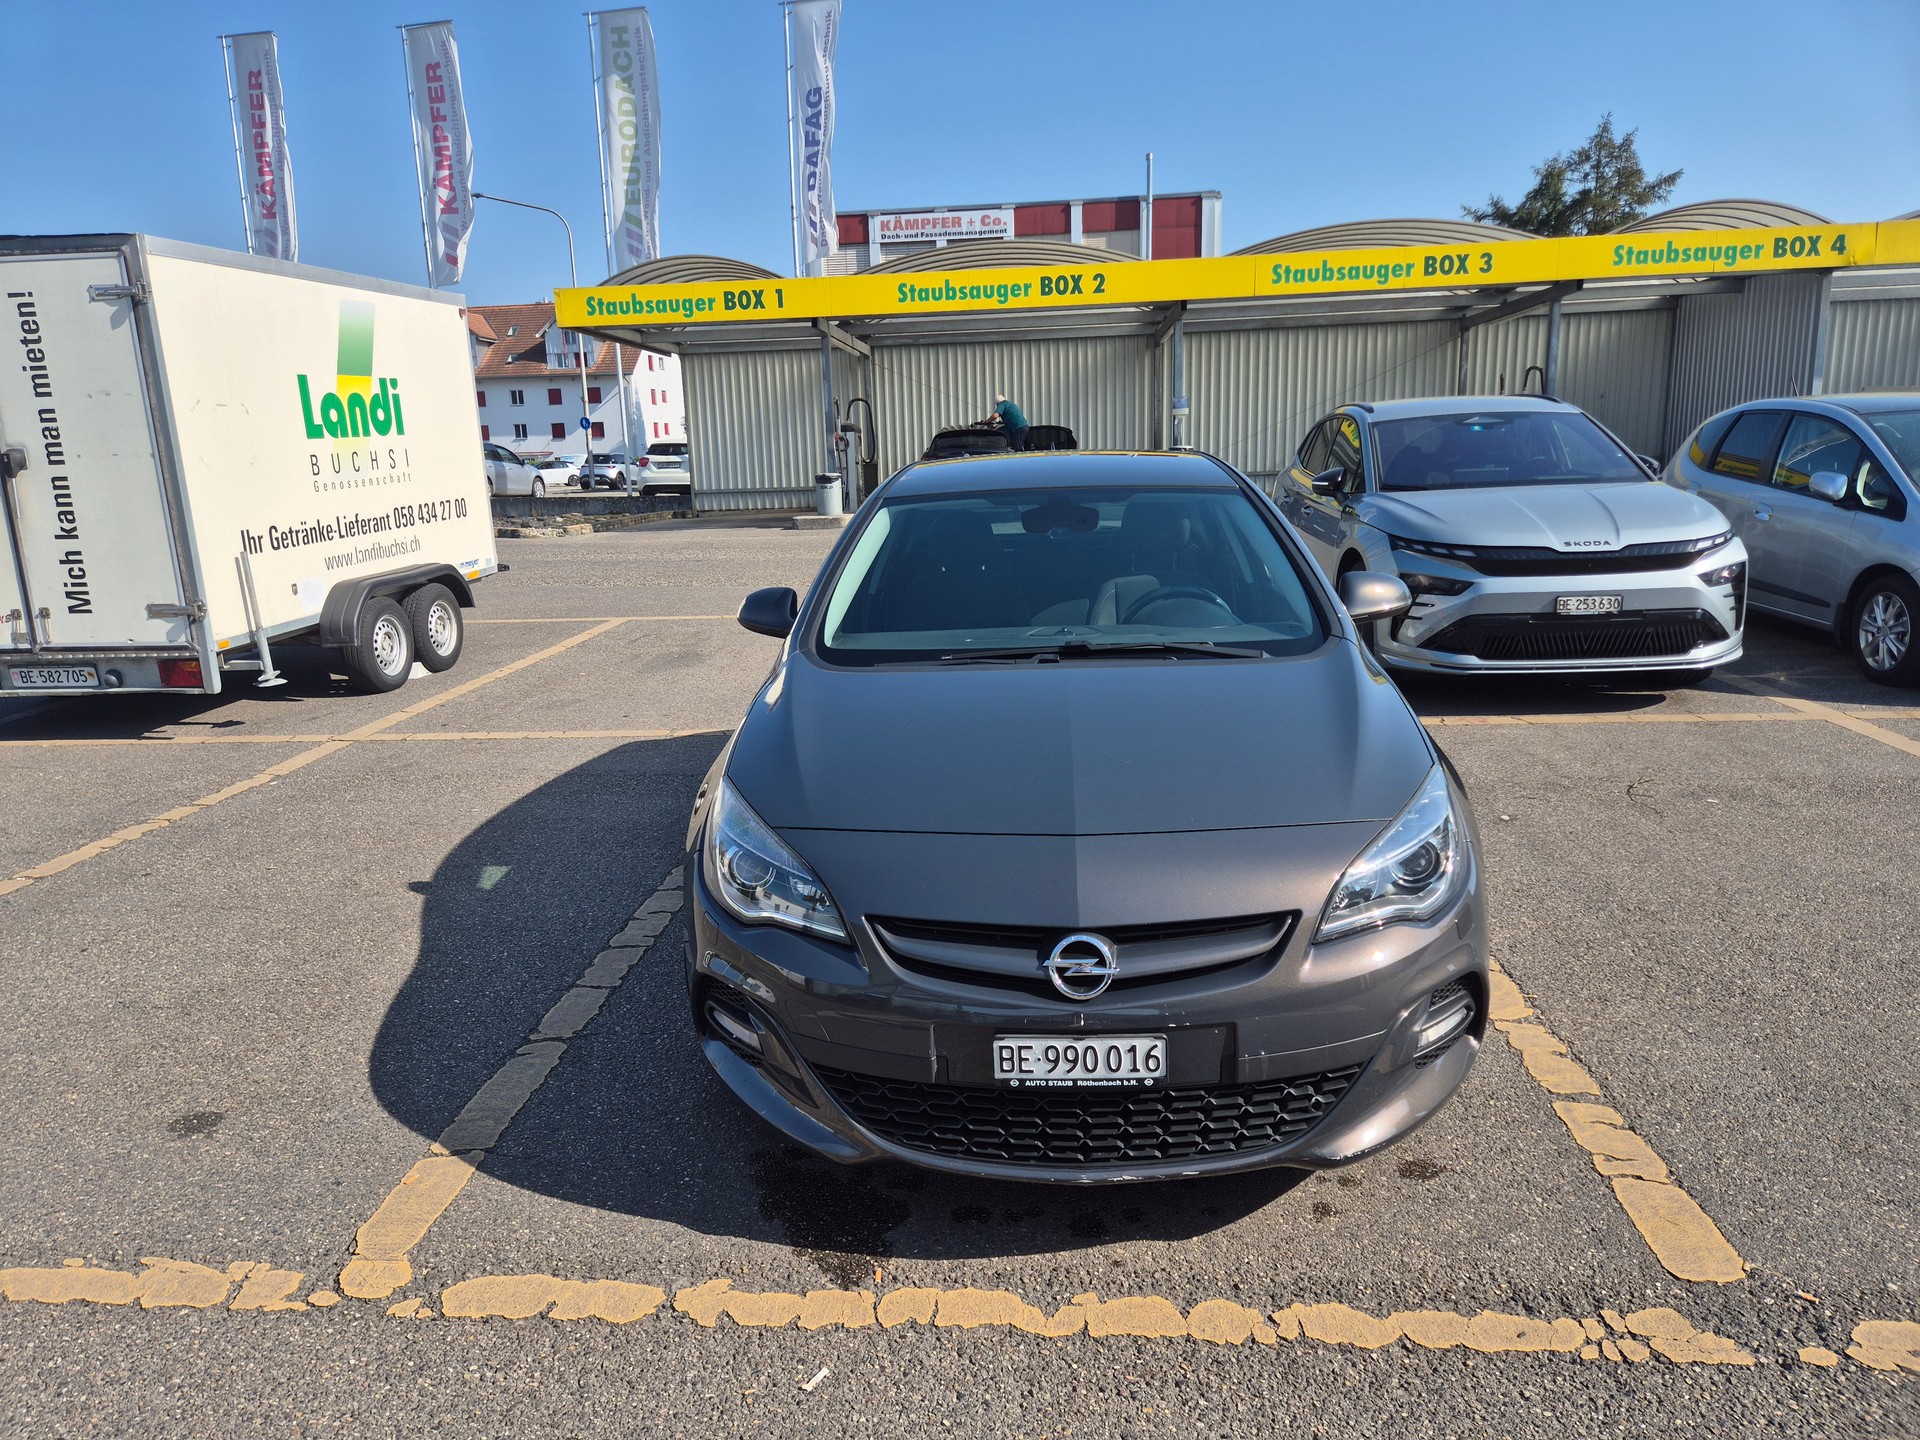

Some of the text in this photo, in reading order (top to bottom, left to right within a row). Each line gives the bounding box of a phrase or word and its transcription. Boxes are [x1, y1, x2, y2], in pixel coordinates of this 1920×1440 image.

[634, 26, 651, 156] Abdichtungstechnik
[611, 26, 642, 206] EURODACH
[248, 69, 277, 220] KÄMPFER
[425, 61, 459, 214] KÄMPFER
[804, 86, 823, 193] DAFAG
[880, 214, 1008, 232] KÄMPFER + Co.
[921, 228, 1008, 239] Fassadenmanagement
[1271, 252, 1493, 285] Staubsauger BOX 3
[1612, 234, 1847, 267] Staubsauger BOX 4
[585, 288, 784, 318] Staubsauger BOX 1
[897, 273, 1106, 304] Staubsauger BOX 2
[296, 374, 405, 440] Landi
[7, 291, 93, 615] Mich kann man mieten!
[309, 448, 410, 476] BUCHSI
[313, 472, 412, 493] Genossenschaft
[240, 497, 468, 555] Ihr Getränke-Lieferant 058 434 27 00
[324, 535, 421, 571] www.landibuchsi.ch
